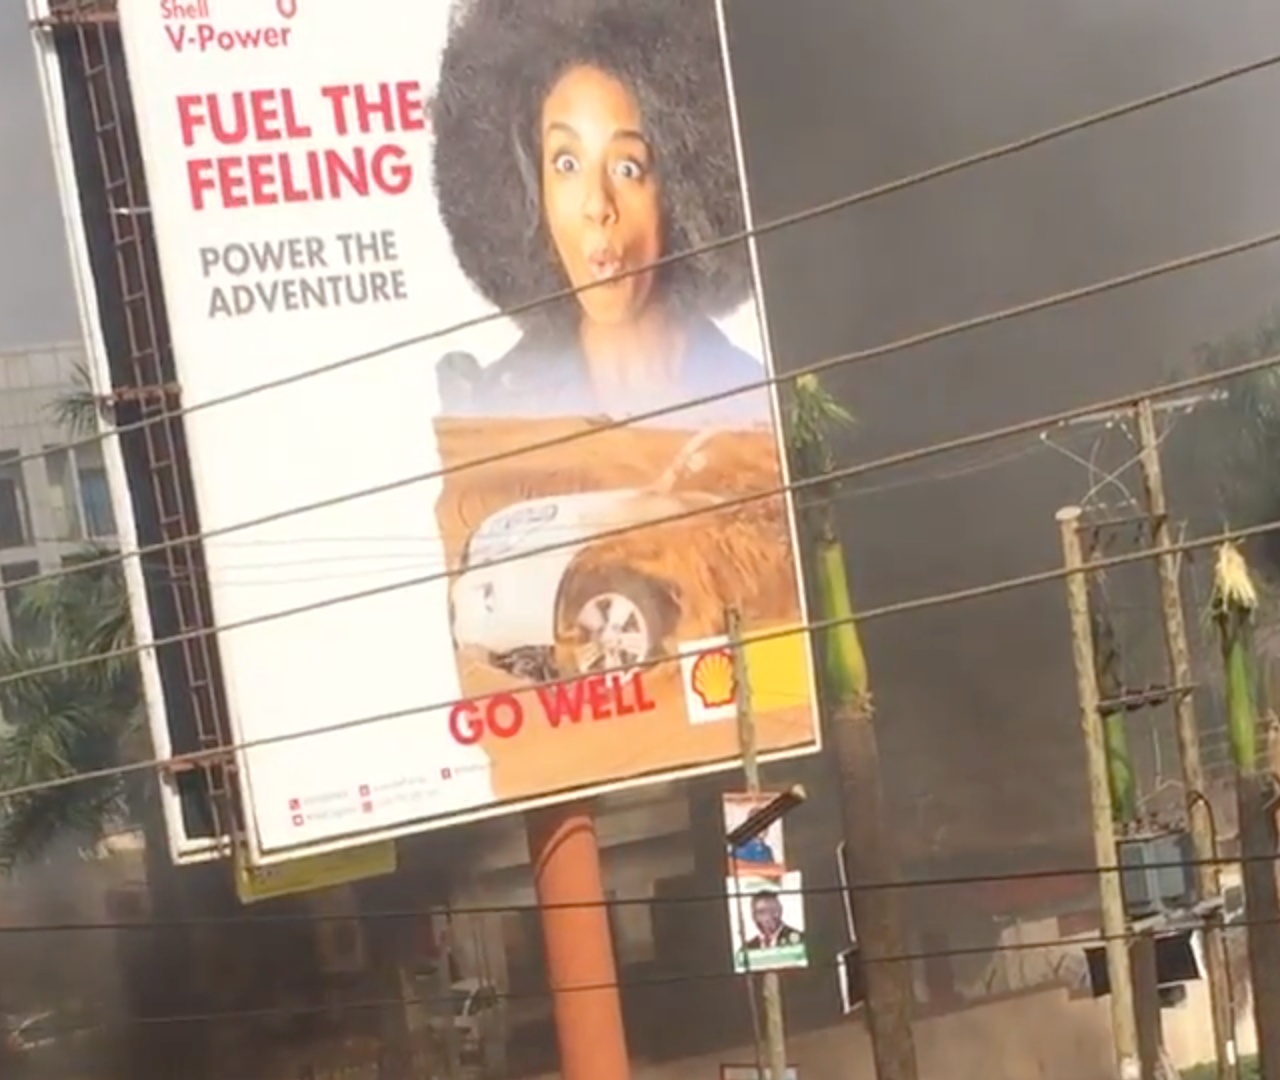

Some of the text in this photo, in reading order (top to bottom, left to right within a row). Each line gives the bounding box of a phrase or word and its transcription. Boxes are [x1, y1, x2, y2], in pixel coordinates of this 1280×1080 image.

[160, 0, 209, 19] Shell
[164, 24, 291, 53] V-Power
[176, 80, 426, 147] FUEL THE
[186, 144, 414, 210] FEELING
[199, 229, 399, 278] POWER THE
[207, 270, 408, 319] ADVENTURE
[449, 671, 656, 746] GO WELL
